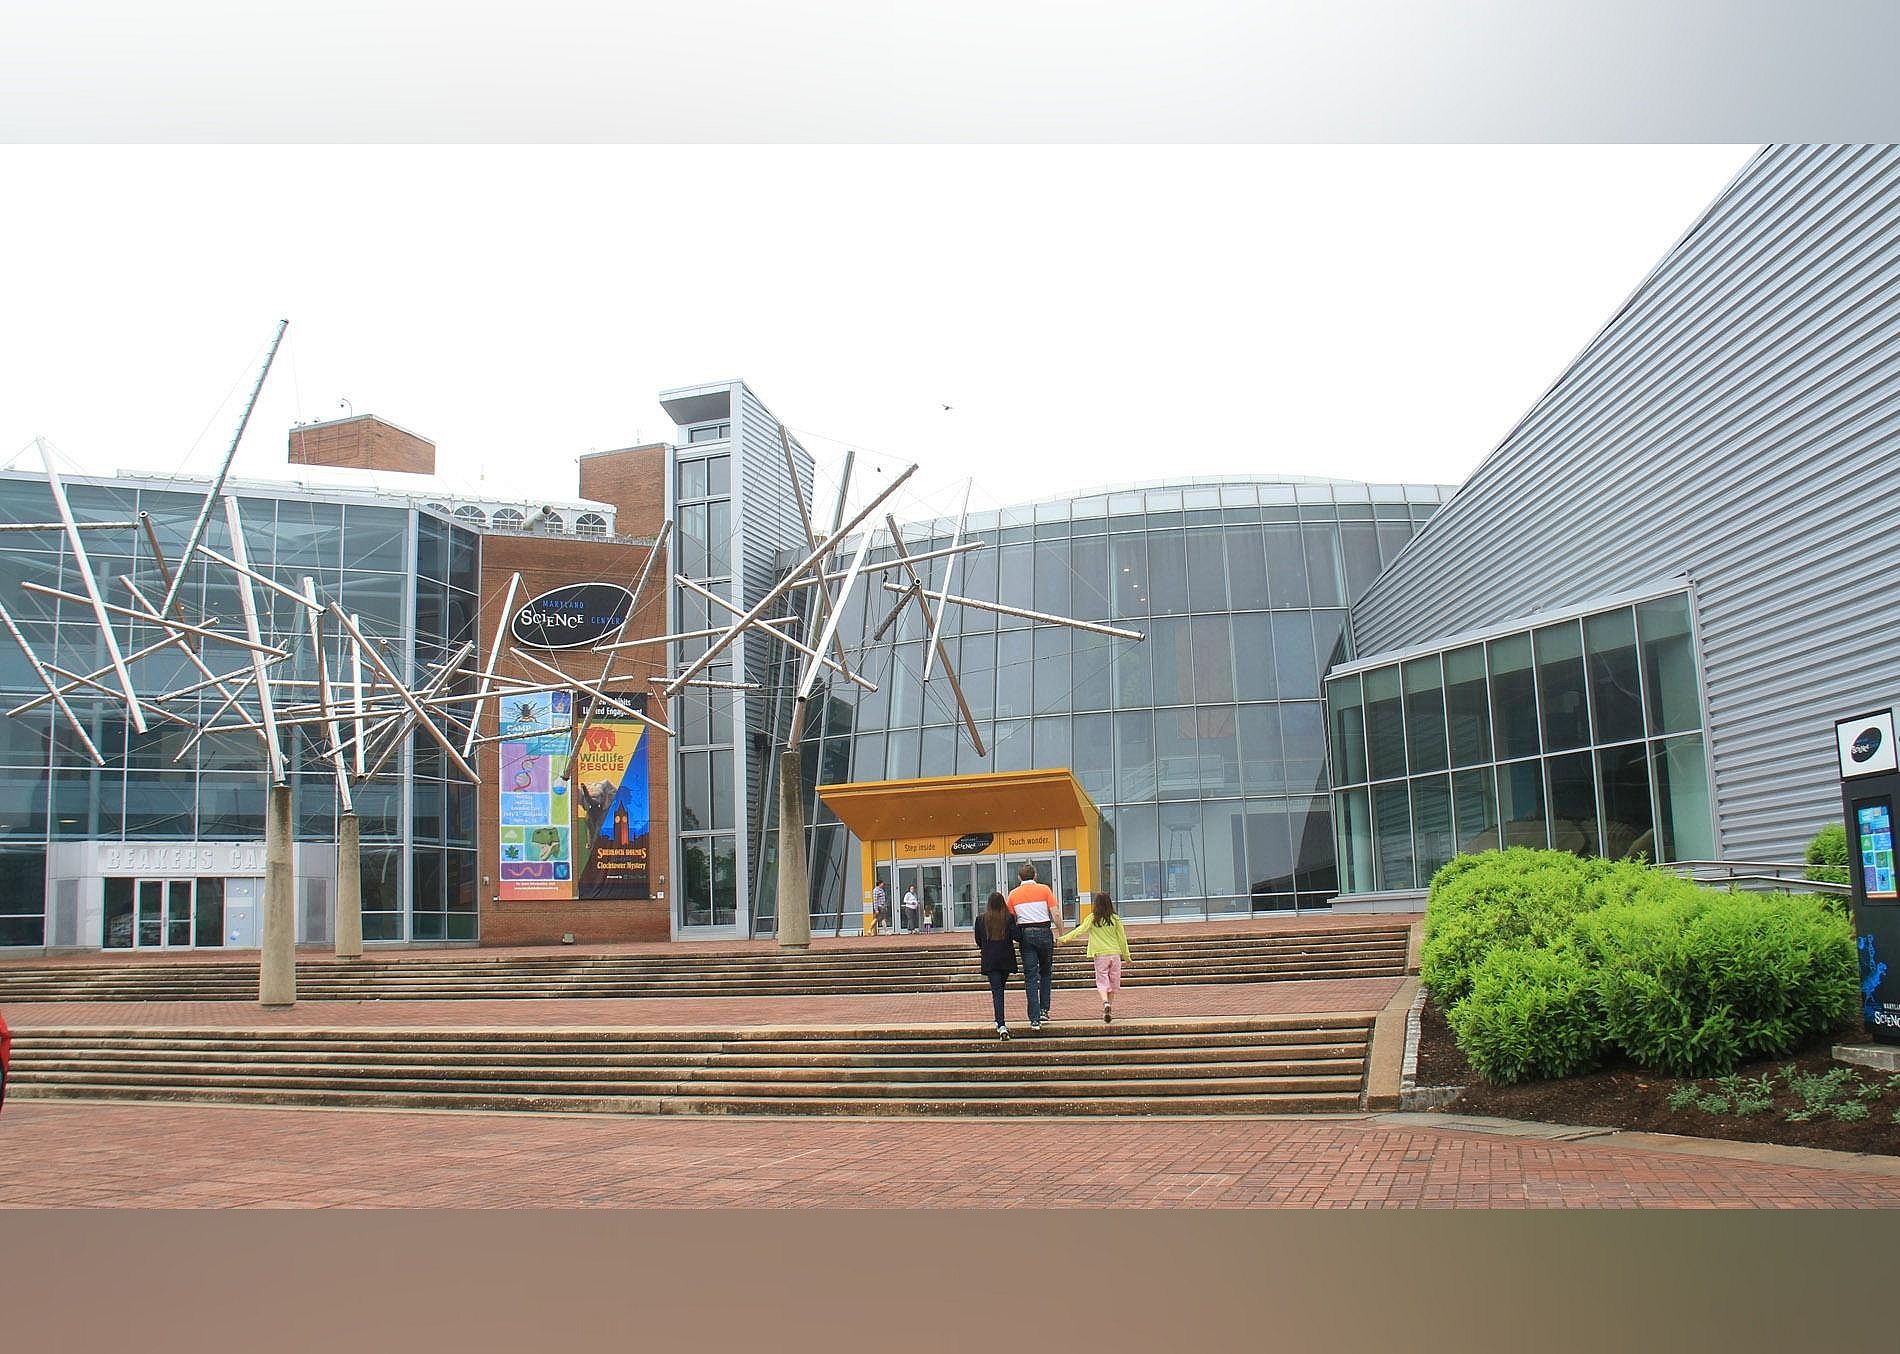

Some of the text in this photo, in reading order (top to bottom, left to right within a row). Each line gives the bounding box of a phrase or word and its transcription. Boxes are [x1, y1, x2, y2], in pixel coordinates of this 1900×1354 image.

[543, 600, 584, 609] MARYLAND
[580, 752, 624, 762] Wildlife
[580, 762, 624, 771] RESCUE
[1008, 837, 1025, 847] Touch
[904, 843, 936, 853] Step inside
[107, 849, 213, 870] BEAKERS
